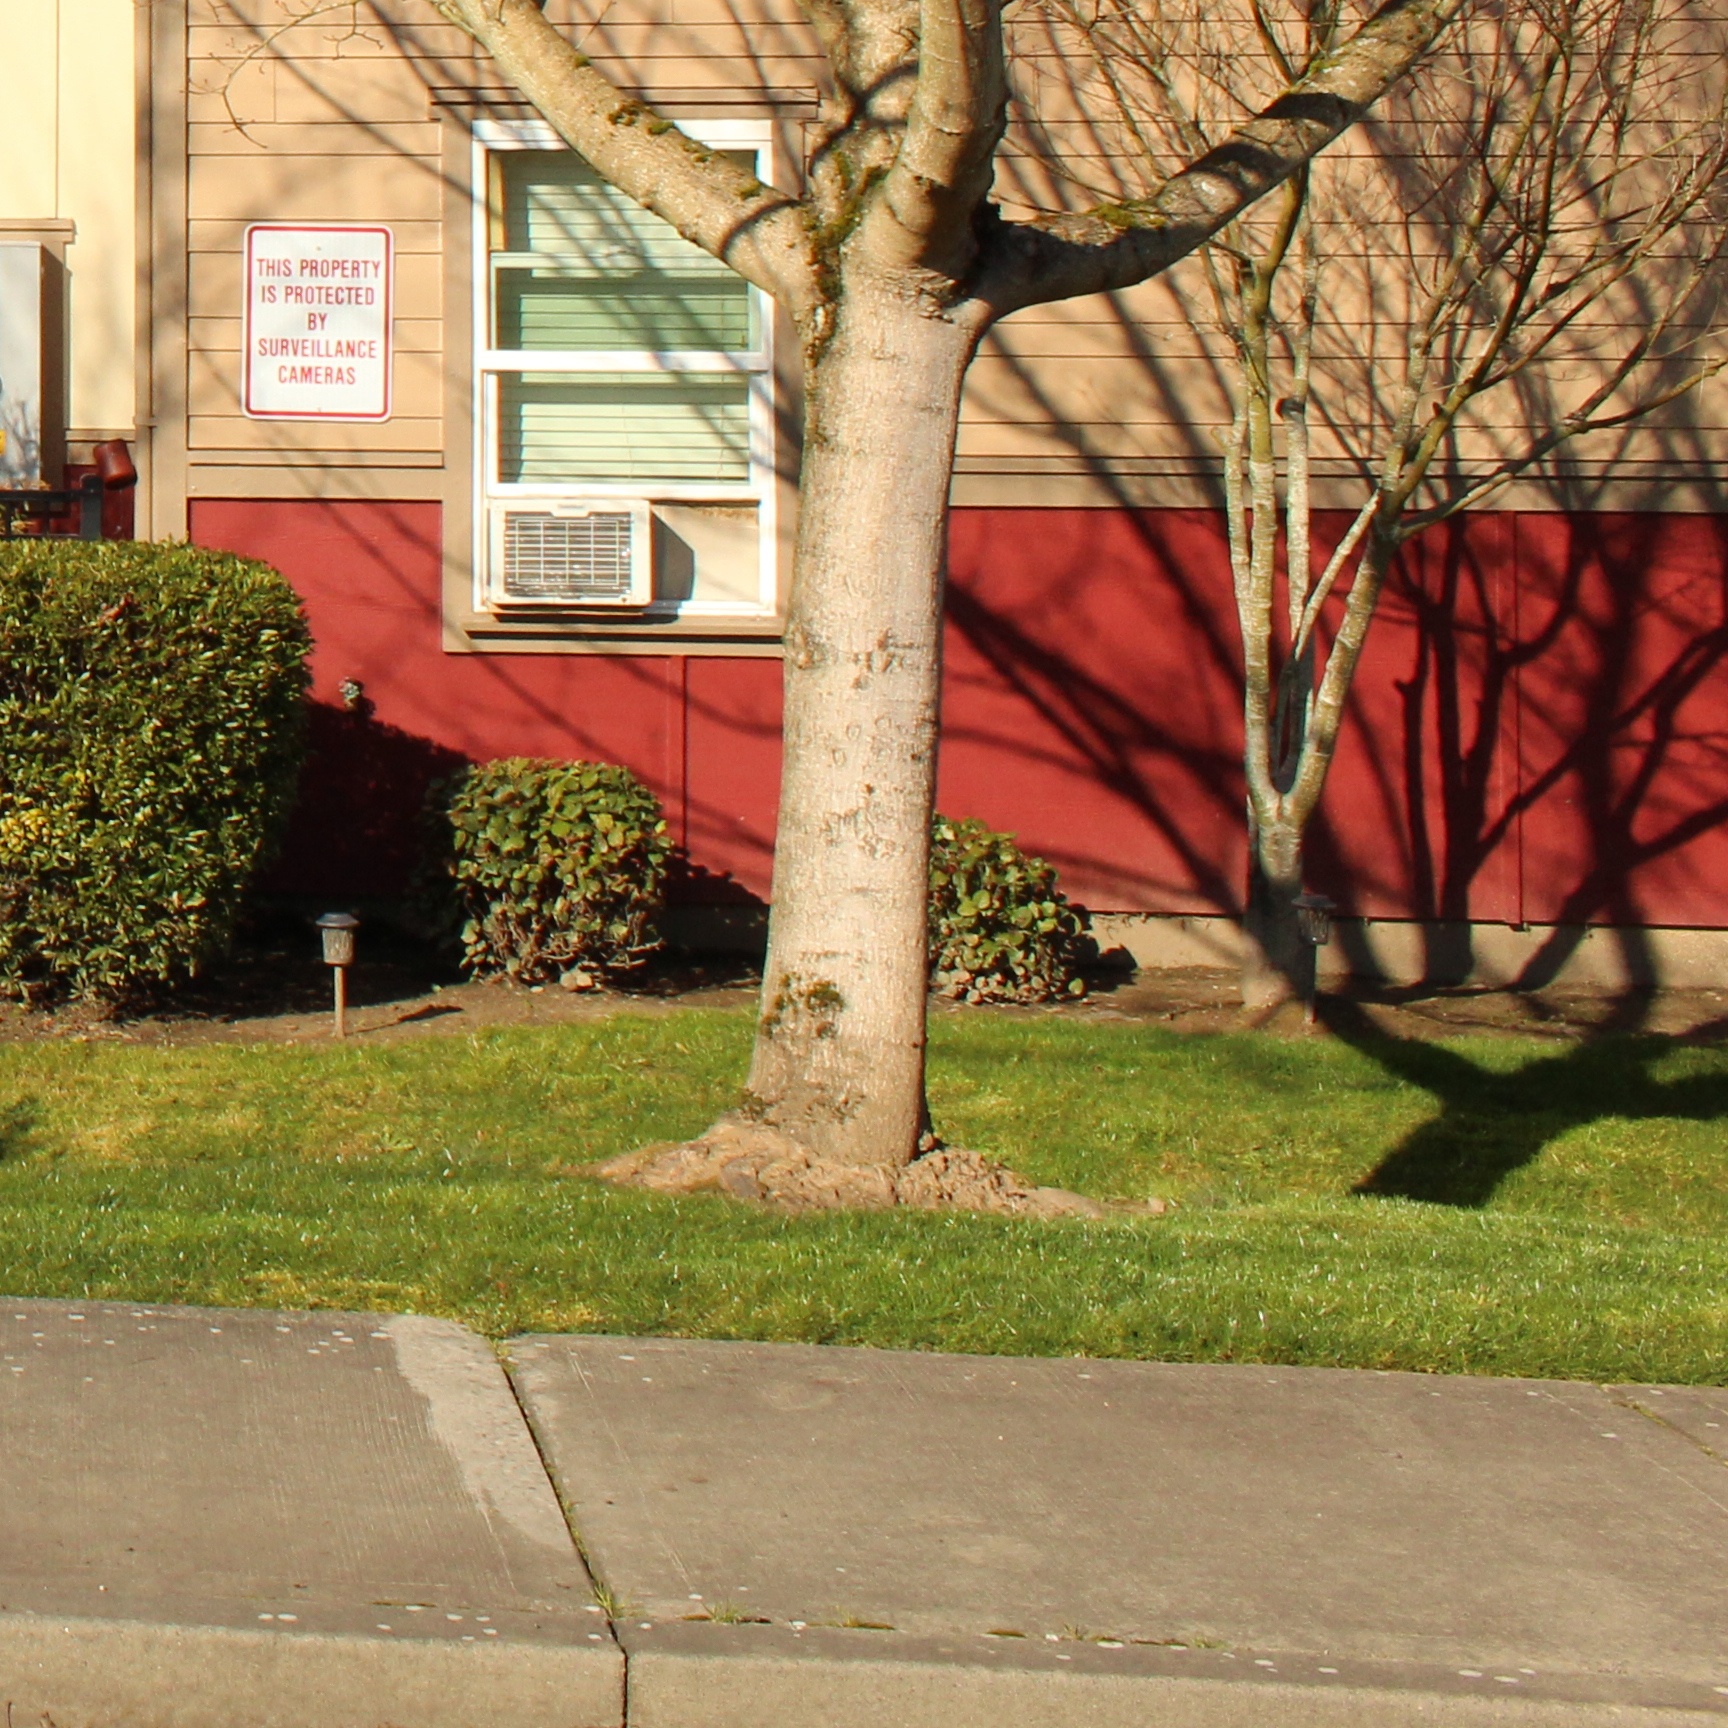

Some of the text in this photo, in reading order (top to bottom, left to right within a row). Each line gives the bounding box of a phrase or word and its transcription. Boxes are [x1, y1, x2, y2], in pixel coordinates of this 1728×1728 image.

[256, 258, 381, 278] THIS PROPERTY
[261, 285, 374, 305] IS PROTECTED
[307, 313, 328, 331] BY
[258, 339, 377, 358] SURVEILLANCE
[278, 366, 355, 385] CAMERAS
